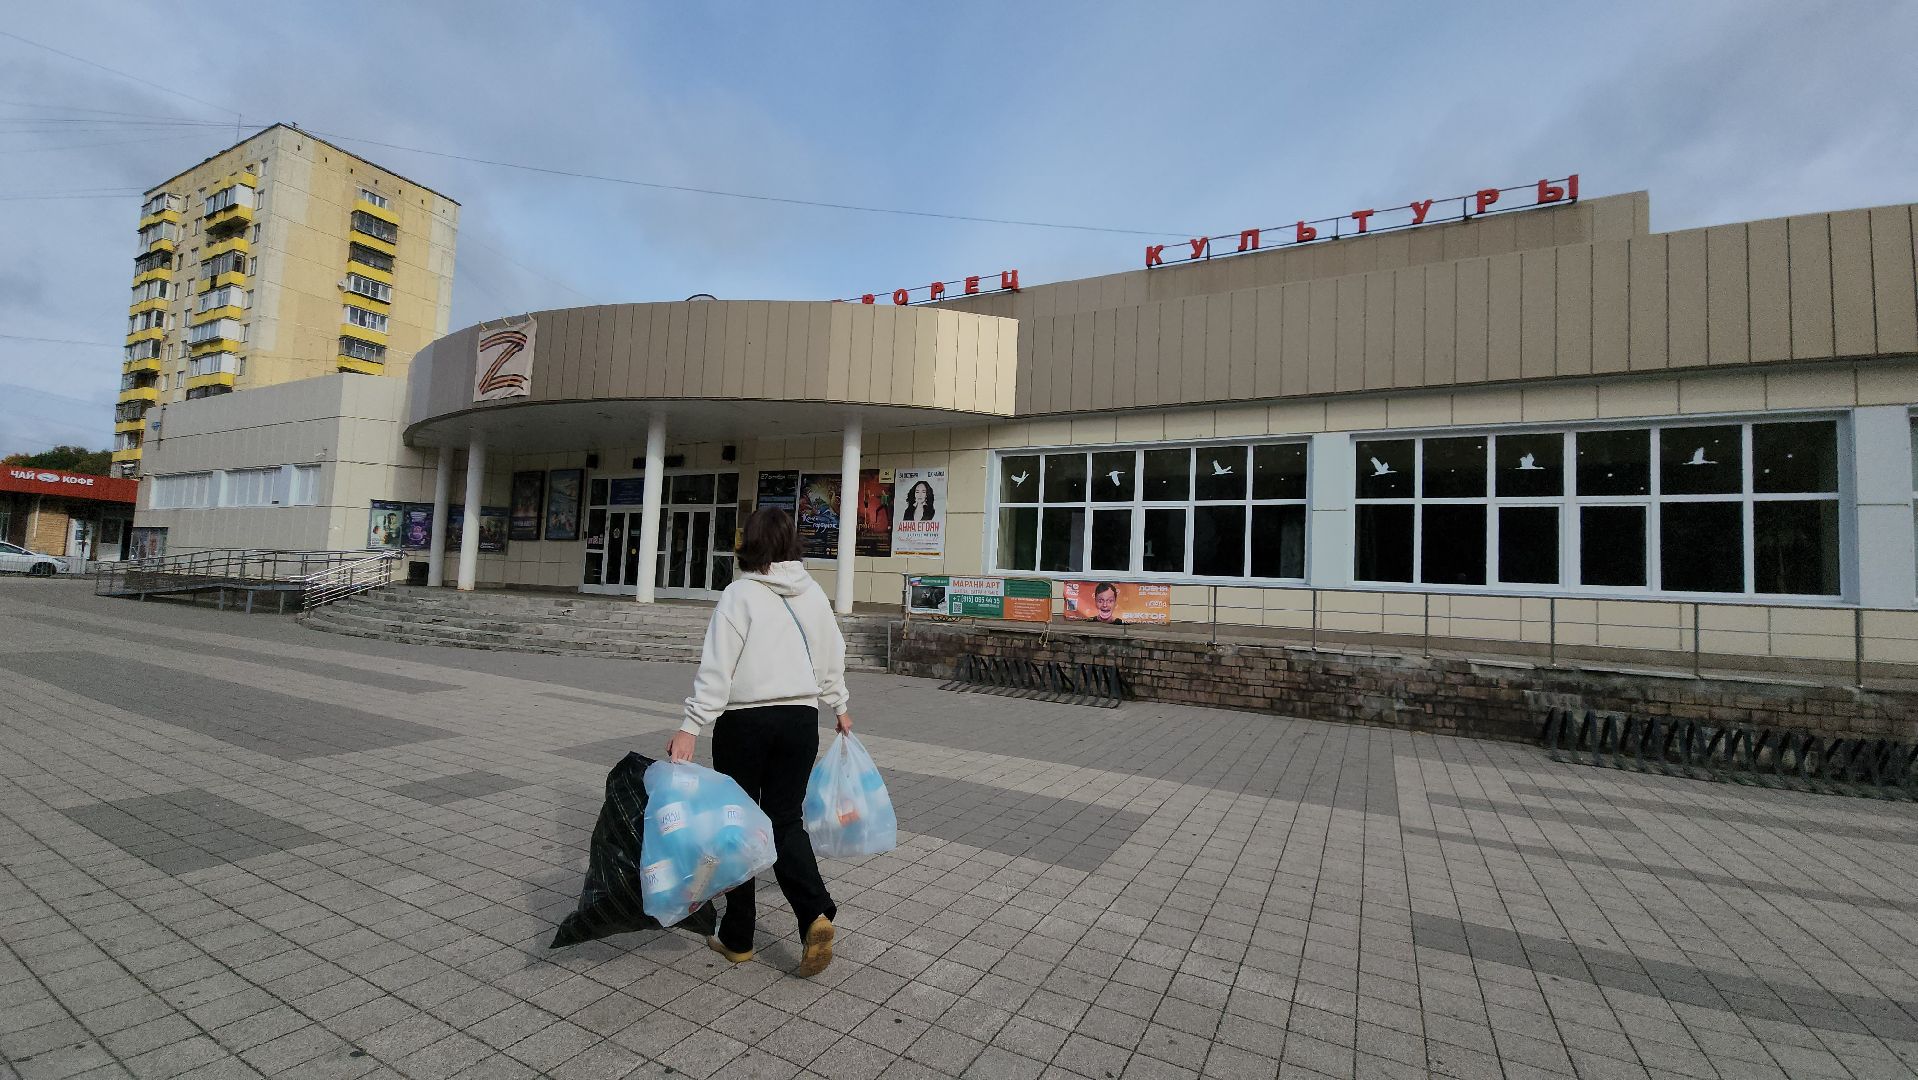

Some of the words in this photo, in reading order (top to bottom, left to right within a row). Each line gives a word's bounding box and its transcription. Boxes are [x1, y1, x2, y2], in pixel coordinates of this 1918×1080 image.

[833, 269, 1019, 306] ВОРЕЦ
[1146, 174, 1580, 269] КУЛЬТУРЫ
[478, 330, 529, 395] Z
[10, 470, 35, 480] ЧАЙ
[62, 475, 94, 486] КОФЕ
[898, 522, 916, 532] АННА
[917, 522, 940, 532] ЕГОЯН
